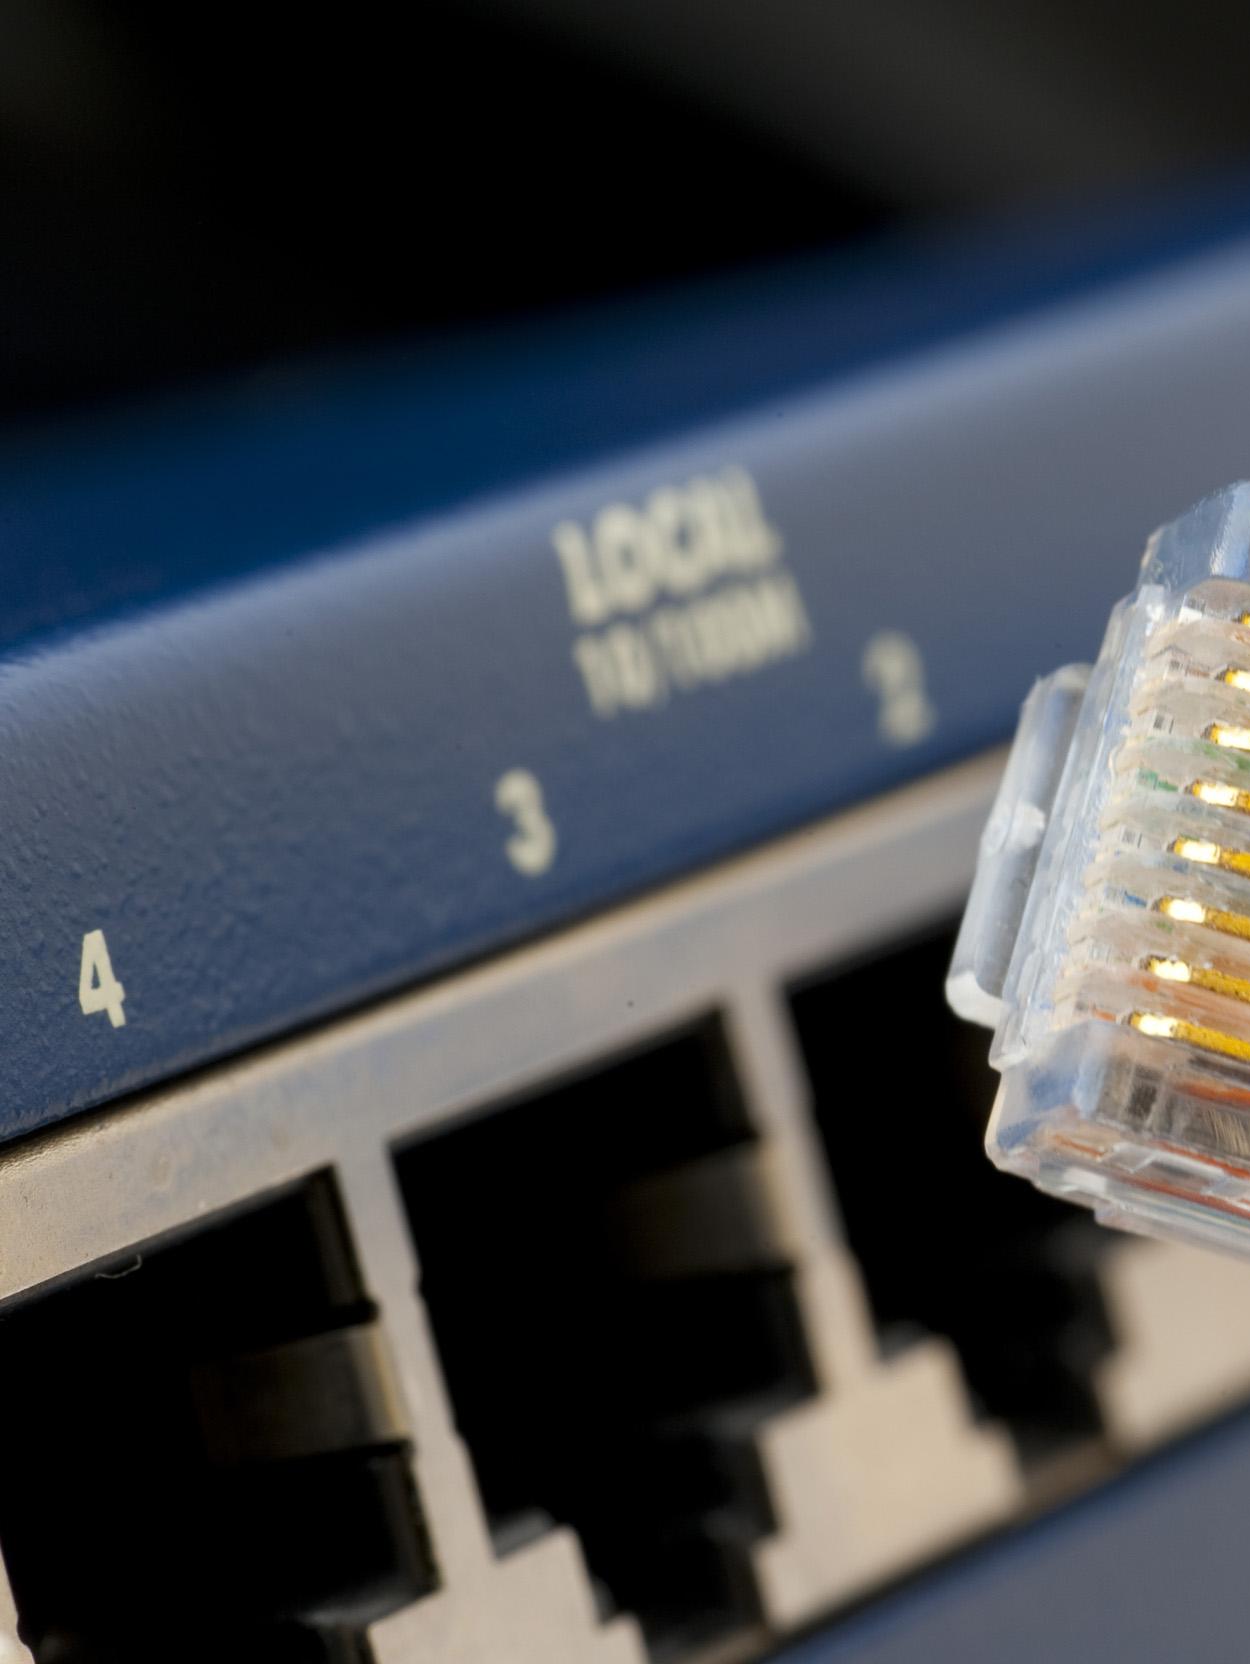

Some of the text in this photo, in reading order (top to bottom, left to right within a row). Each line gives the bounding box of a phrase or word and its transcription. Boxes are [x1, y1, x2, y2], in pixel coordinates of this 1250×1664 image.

[552, 466, 782, 627] LOCAL
[864, 631, 934, 745] 2
[496, 769, 556, 876] 3
[79, 929, 126, 1028] 4
